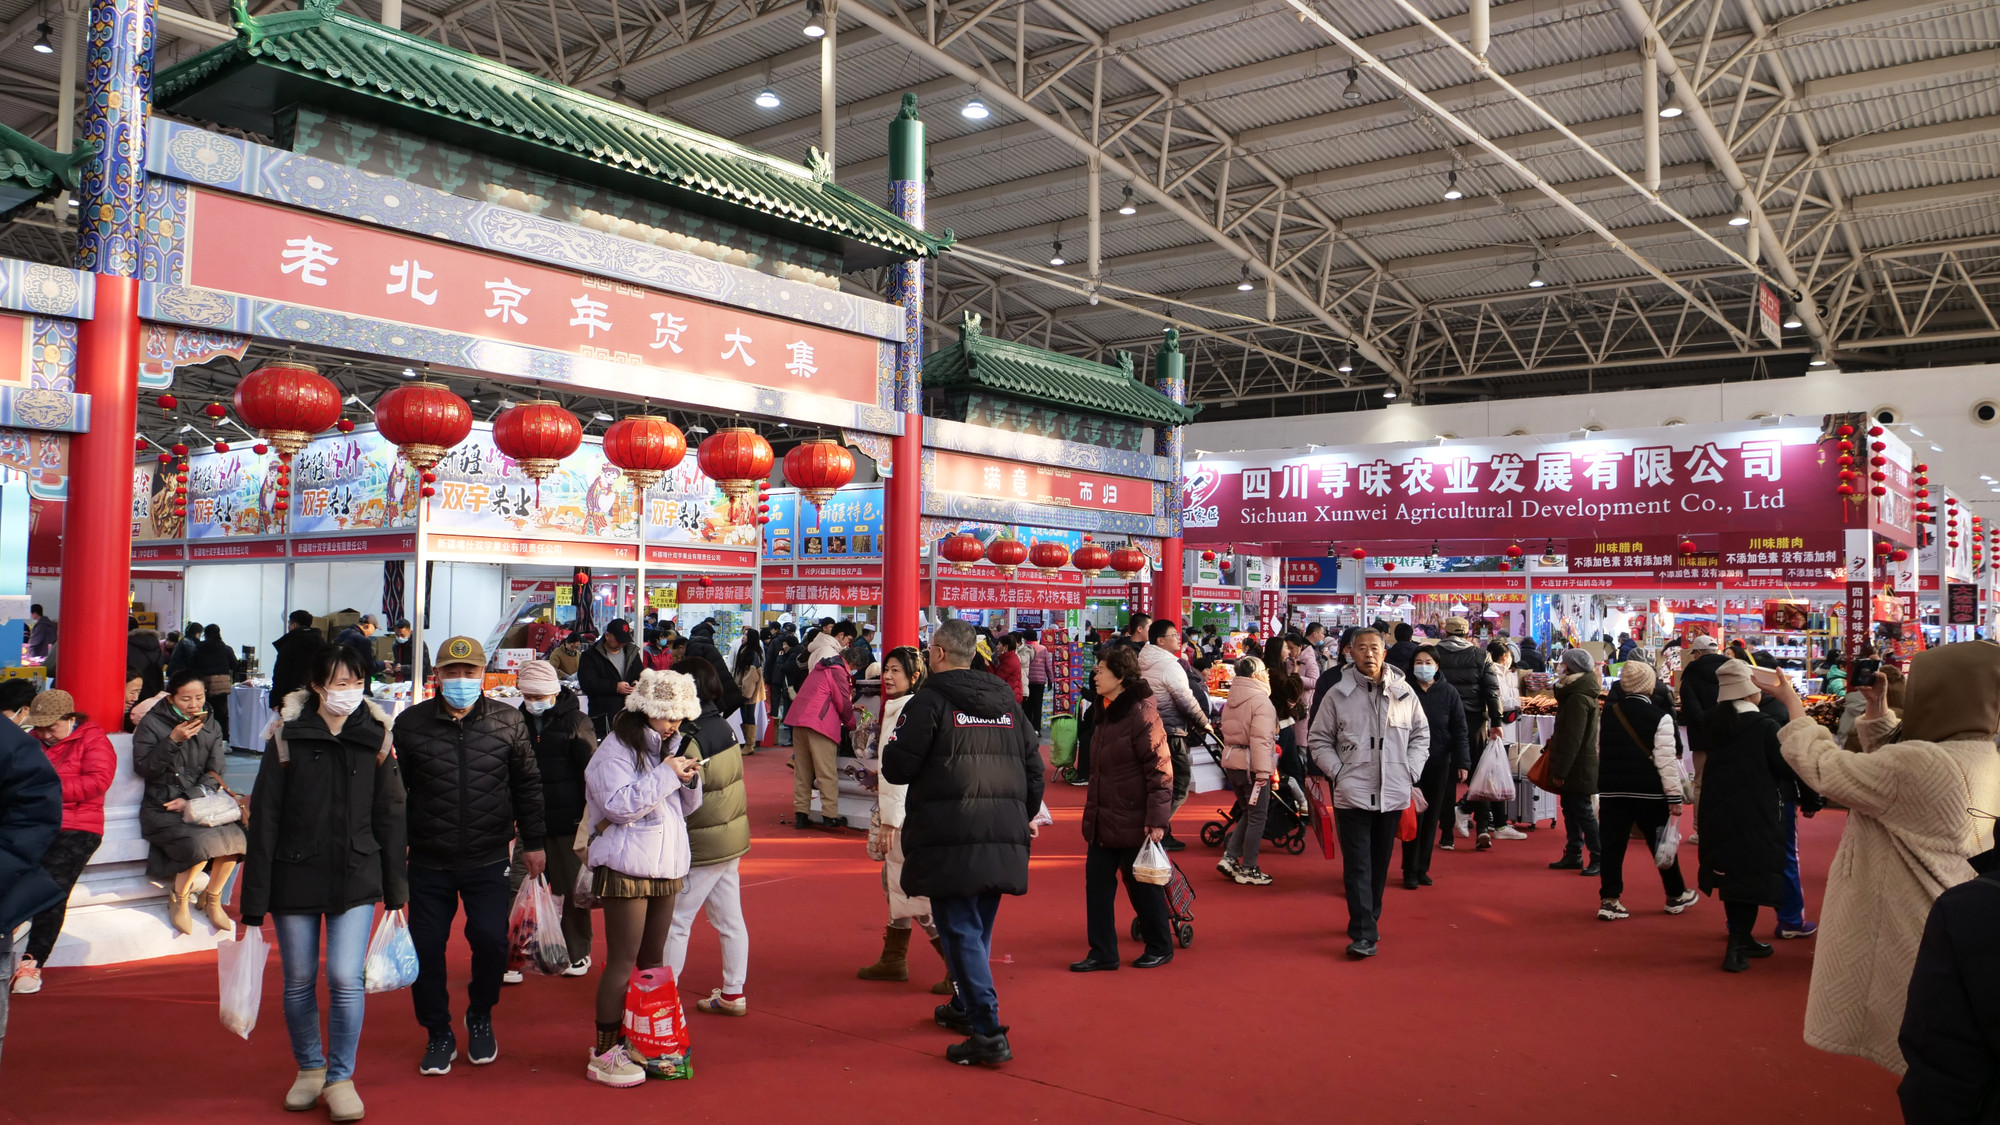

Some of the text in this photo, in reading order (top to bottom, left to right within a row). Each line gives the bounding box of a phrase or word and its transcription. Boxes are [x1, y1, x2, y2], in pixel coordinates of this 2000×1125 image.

[280, 234, 819, 379] 老北京年货大集
[1241, 440, 1783, 500] 四川寻味农业发展有限公司
[983, 465, 1118, 505] 满意而归
[301, 484, 354, 518] 双宇果业
[441, 481, 532, 517] 双宇果业
[1240, 488, 1786, 525] Sichuan Xunwei Agricultural Development Co., Ltd
[651, 499, 701, 530] 双宇果业
[297, 538, 413, 553] 新疆喀什双宇果业有限责任公司 T47
[437, 538, 628, 557] 新疆喀什双宇果业有限责任公司 T47
[1594, 541, 1643, 554] 川味腊肉
[1748, 536, 1805, 550] 川味腊肉
[652, 551, 721, 562] 新疆喀什双宇果业有限责任公司
[1574, 554, 1673, 568] 不添加色素 没有添加剂
[1725, 550, 1837, 565] 不添加色素 没有添加剂
[1506, 579, 1519, 587] T10
